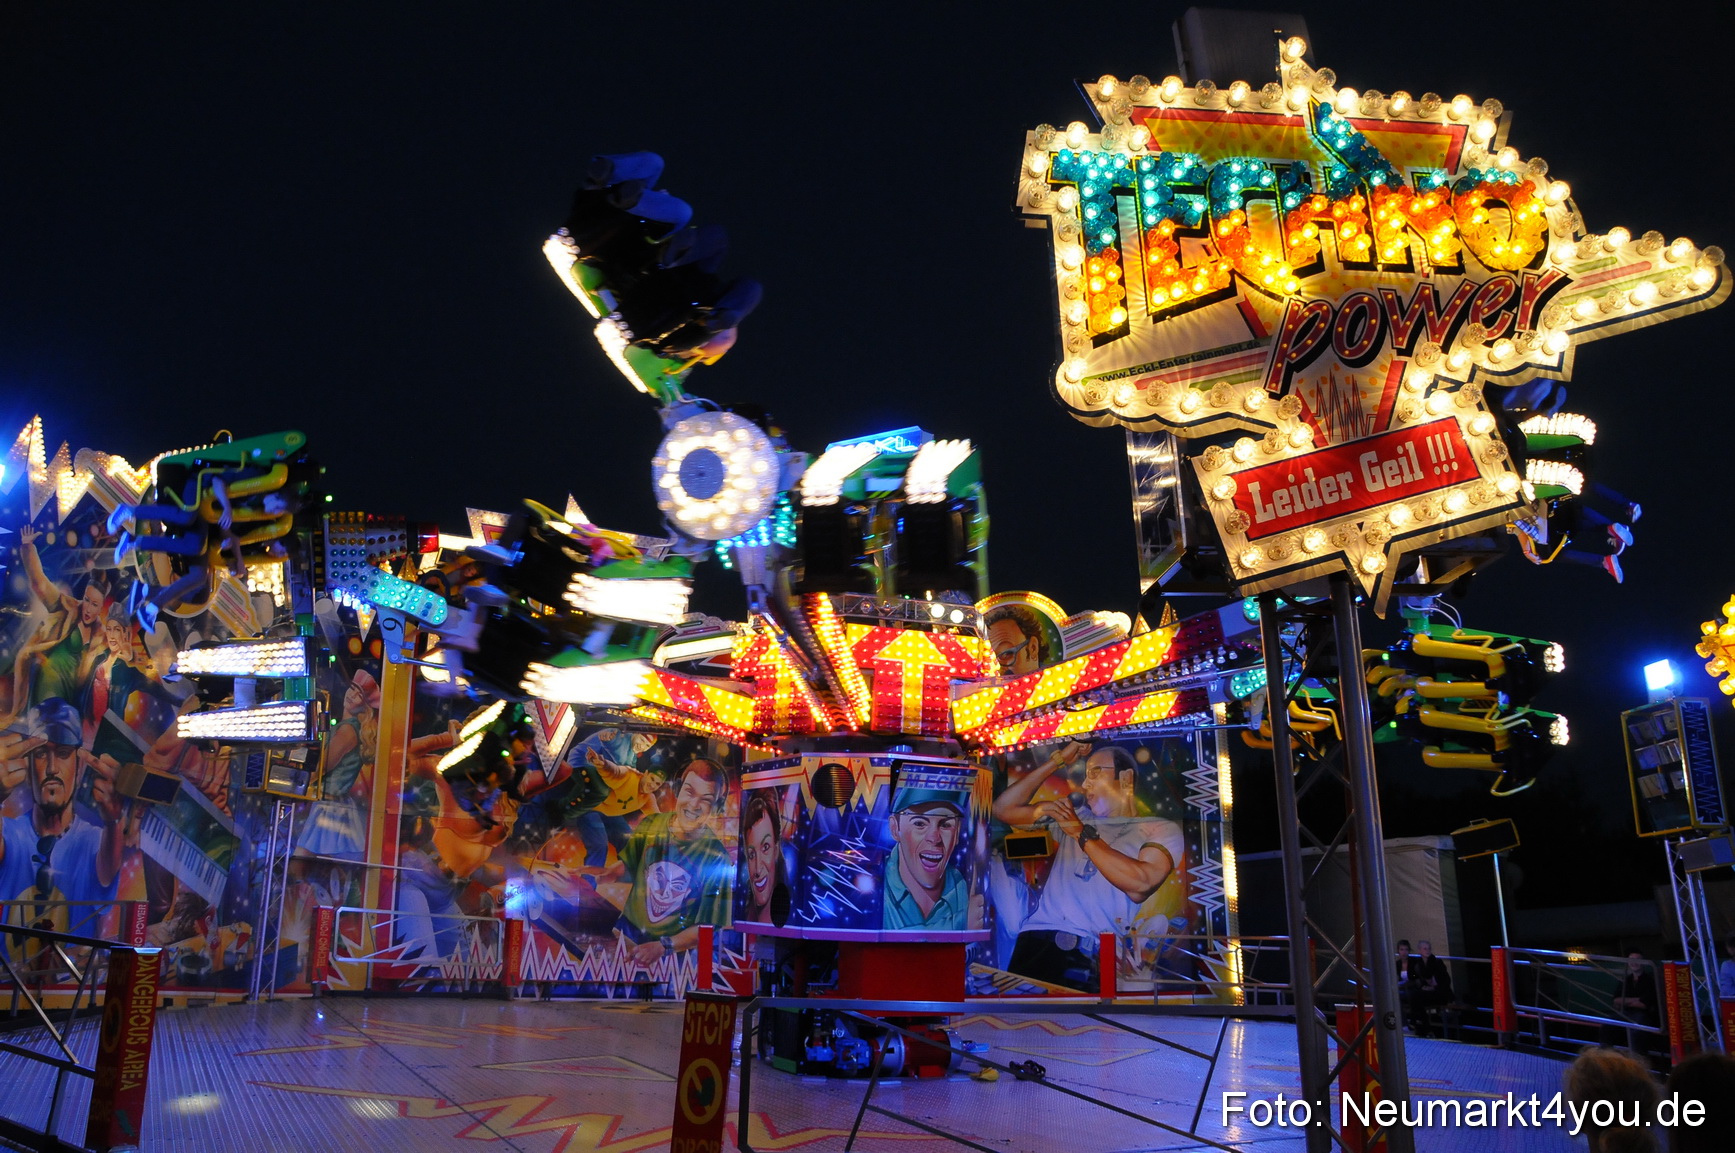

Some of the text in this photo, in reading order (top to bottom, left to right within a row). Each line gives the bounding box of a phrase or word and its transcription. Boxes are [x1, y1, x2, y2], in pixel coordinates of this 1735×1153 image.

[1047, 103, 1552, 345] TECHNO
[1262, 267, 1571, 396] power
[1248, 431, 1459, 524] Leider Geil !!!
[1114, 688, 1141, 698] Power
[1154, 681, 1168, 690] the
[1170, 676, 1201, 689] people
[904, 773, 970, 791] M.ECKL
[120, 953, 159, 1091] DANGEROUS AREA
[685, 1001, 731, 1045] STOP
[1664, 968, 1678, 1046] TECHNO POWER
[1676, 967, 1696, 1042] DANGEROUS AREA
